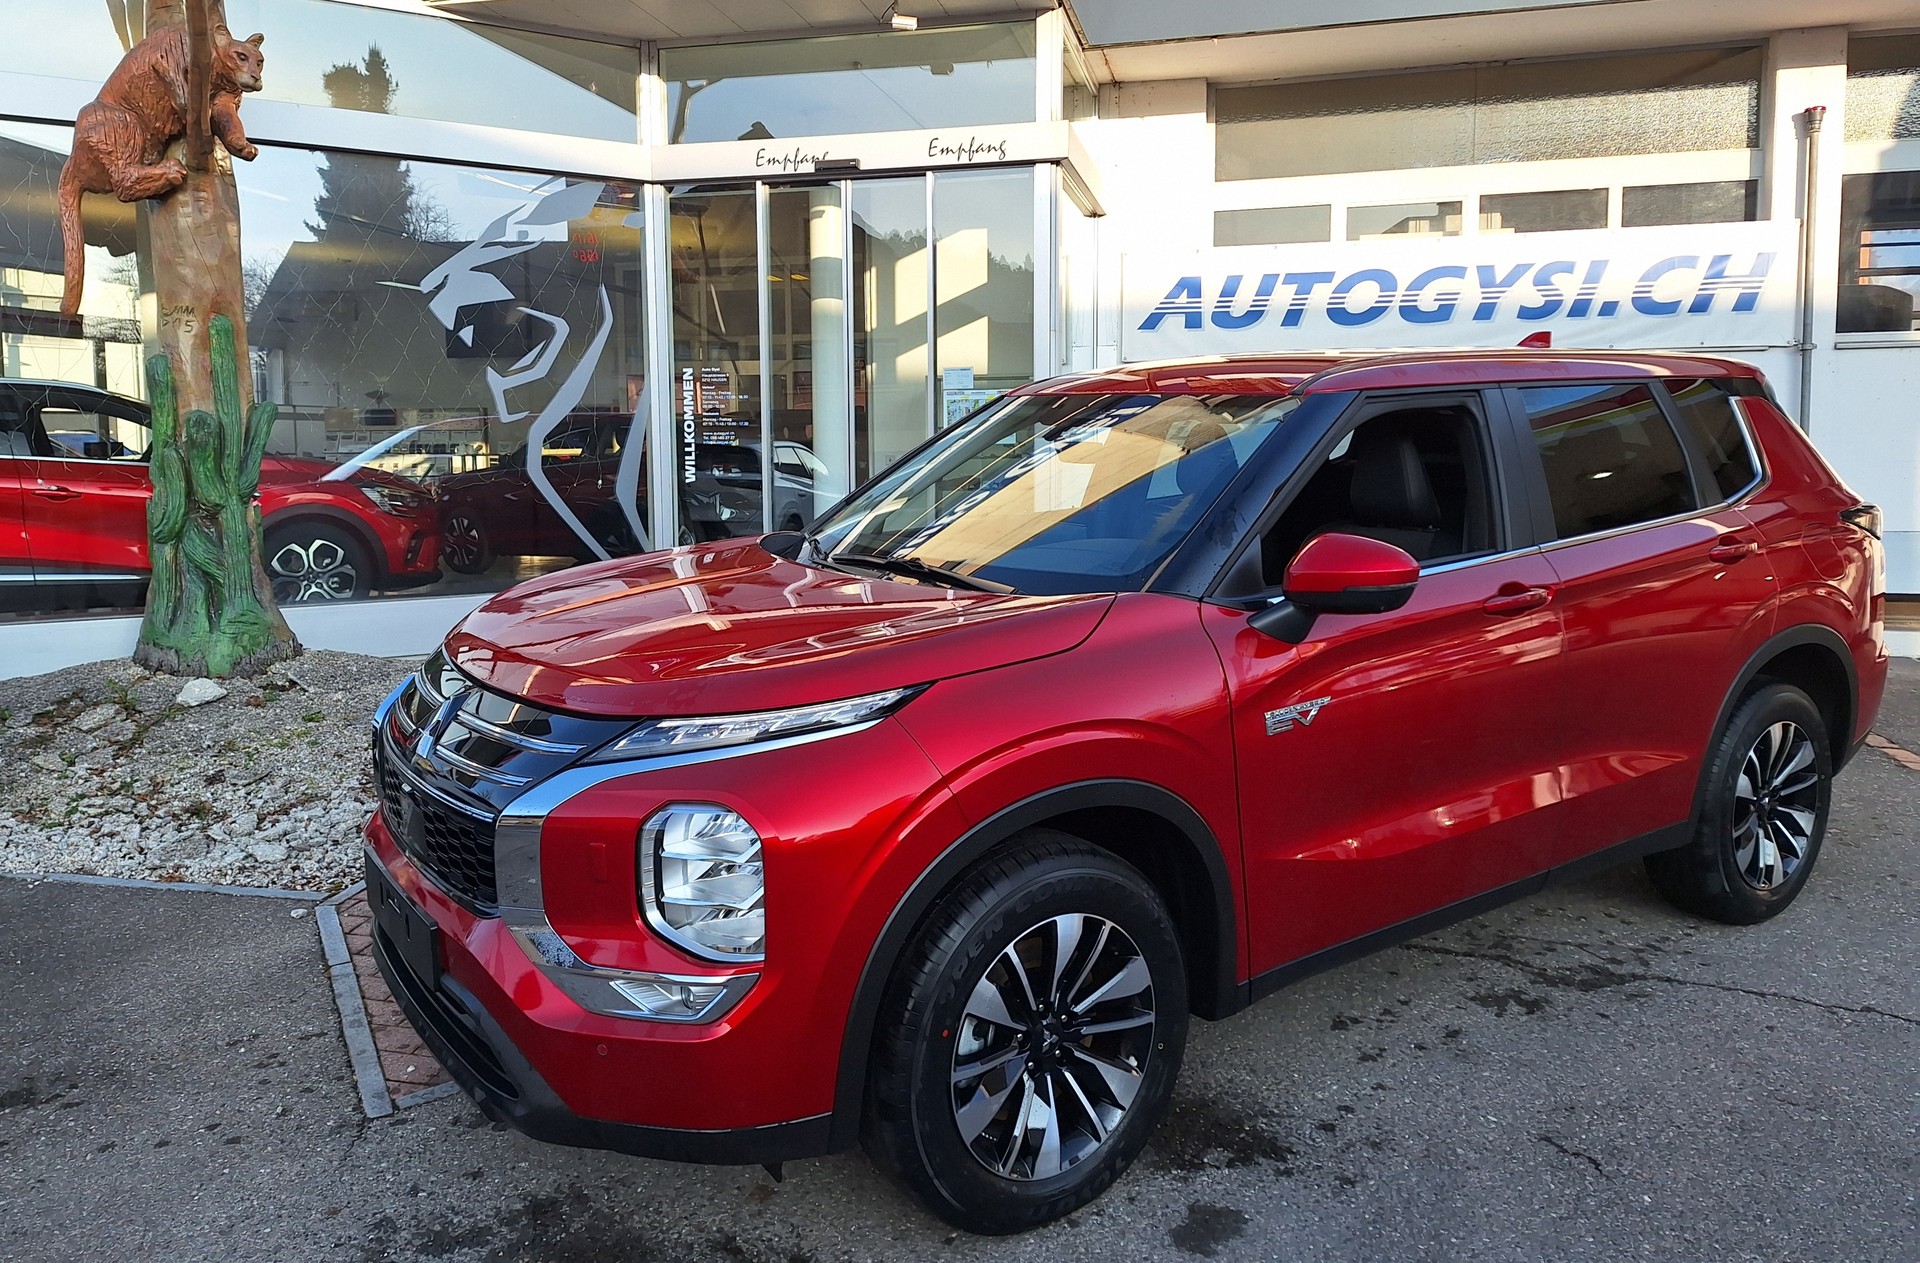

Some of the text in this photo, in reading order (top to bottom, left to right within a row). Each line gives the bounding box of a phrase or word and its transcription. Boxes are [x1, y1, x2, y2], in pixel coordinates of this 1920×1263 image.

[928, 136, 1006, 162] Empfang
[1137, 252, 1777, 330] AUTOGYSI.CH
[682, 367, 695, 484] WILLKOMMEN
